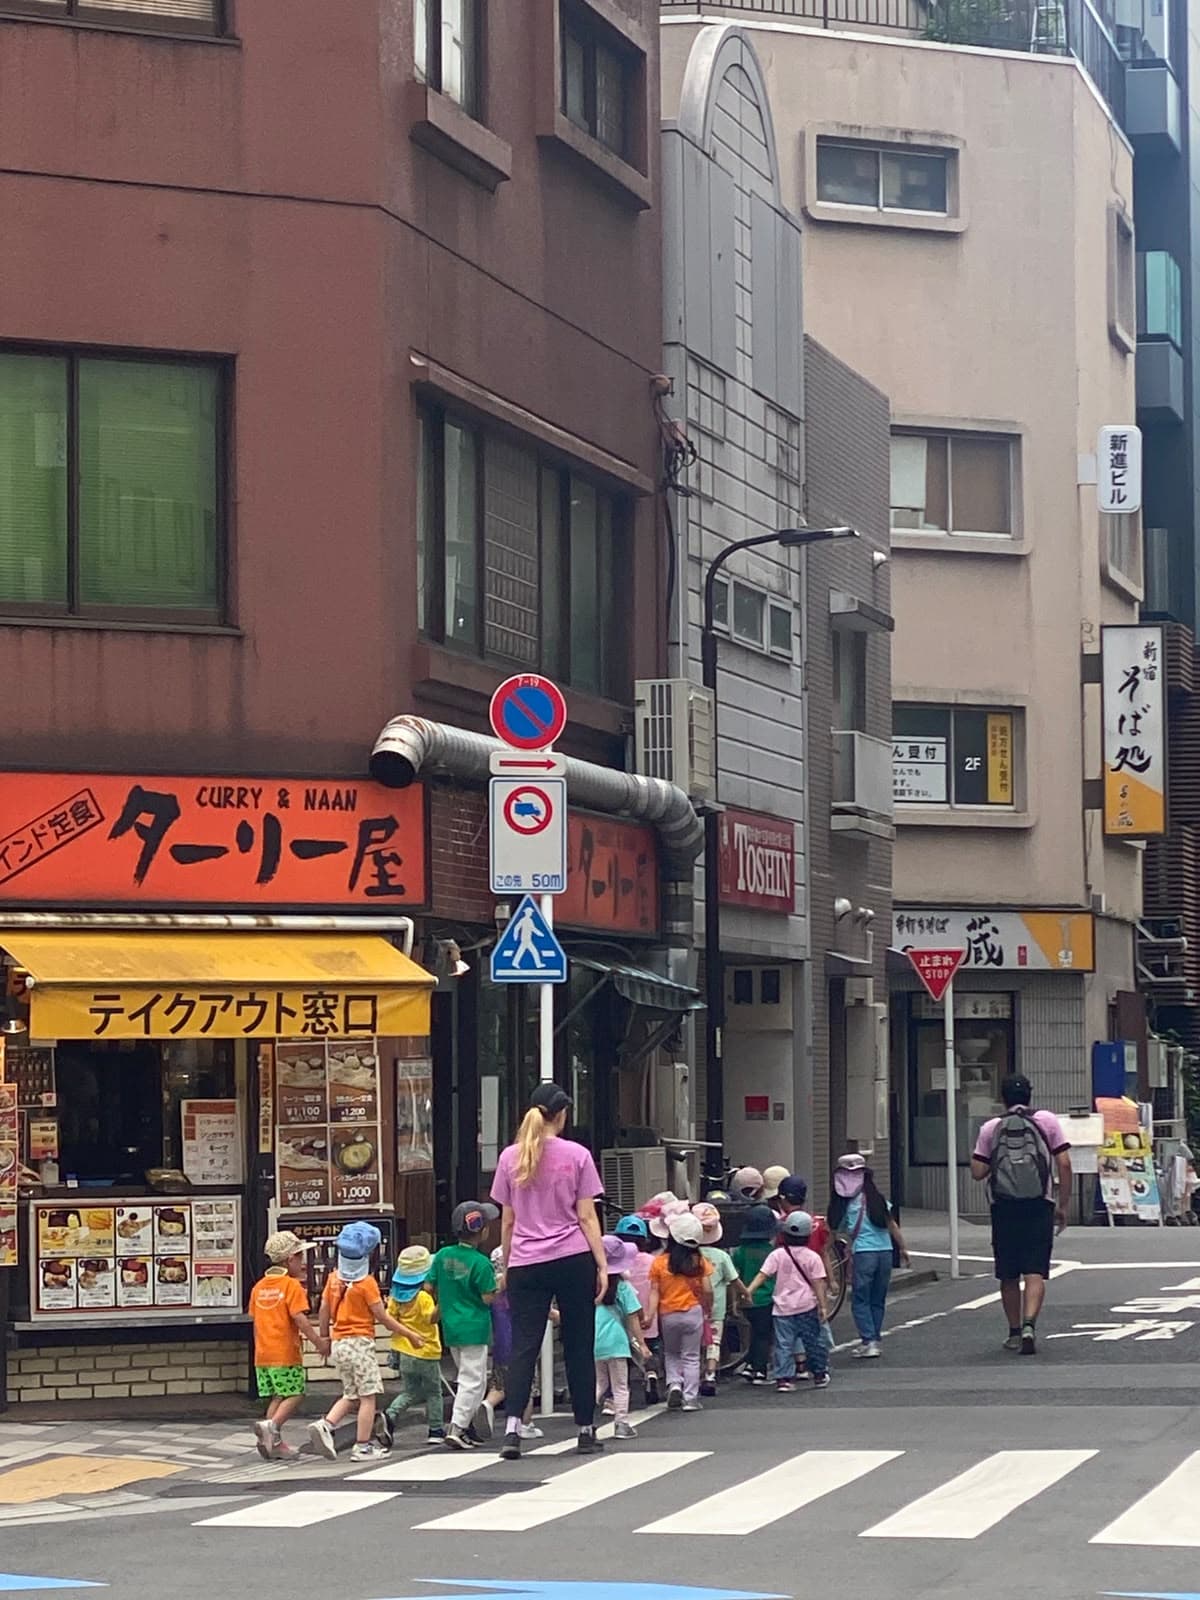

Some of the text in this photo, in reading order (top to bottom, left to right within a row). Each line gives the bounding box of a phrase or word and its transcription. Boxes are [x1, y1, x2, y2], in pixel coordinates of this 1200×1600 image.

[1109, 434, 1128, 504] 新進ビル
[1143, 641, 1158, 681] 新宿
[517, 677, 540, 687] 7-19
[1110, 665, 1152, 773] そば処
[965, 757, 981, 771] 2F
[195, 786, 358, 812] CURRY & NAAN
[0, 799, 96, 870] インド定食
[108, 784, 406, 897] ターリー屋
[496, 873, 561, 888] この先 50m
[959, 915, 1004, 966] 蔵
[919, 955, 954, 967] 止まれ
[925, 968, 949, 980] STOP
[89, 991, 378, 1035] テイクアウト窓口
[336, 1186, 371, 1199] ¥1,000
